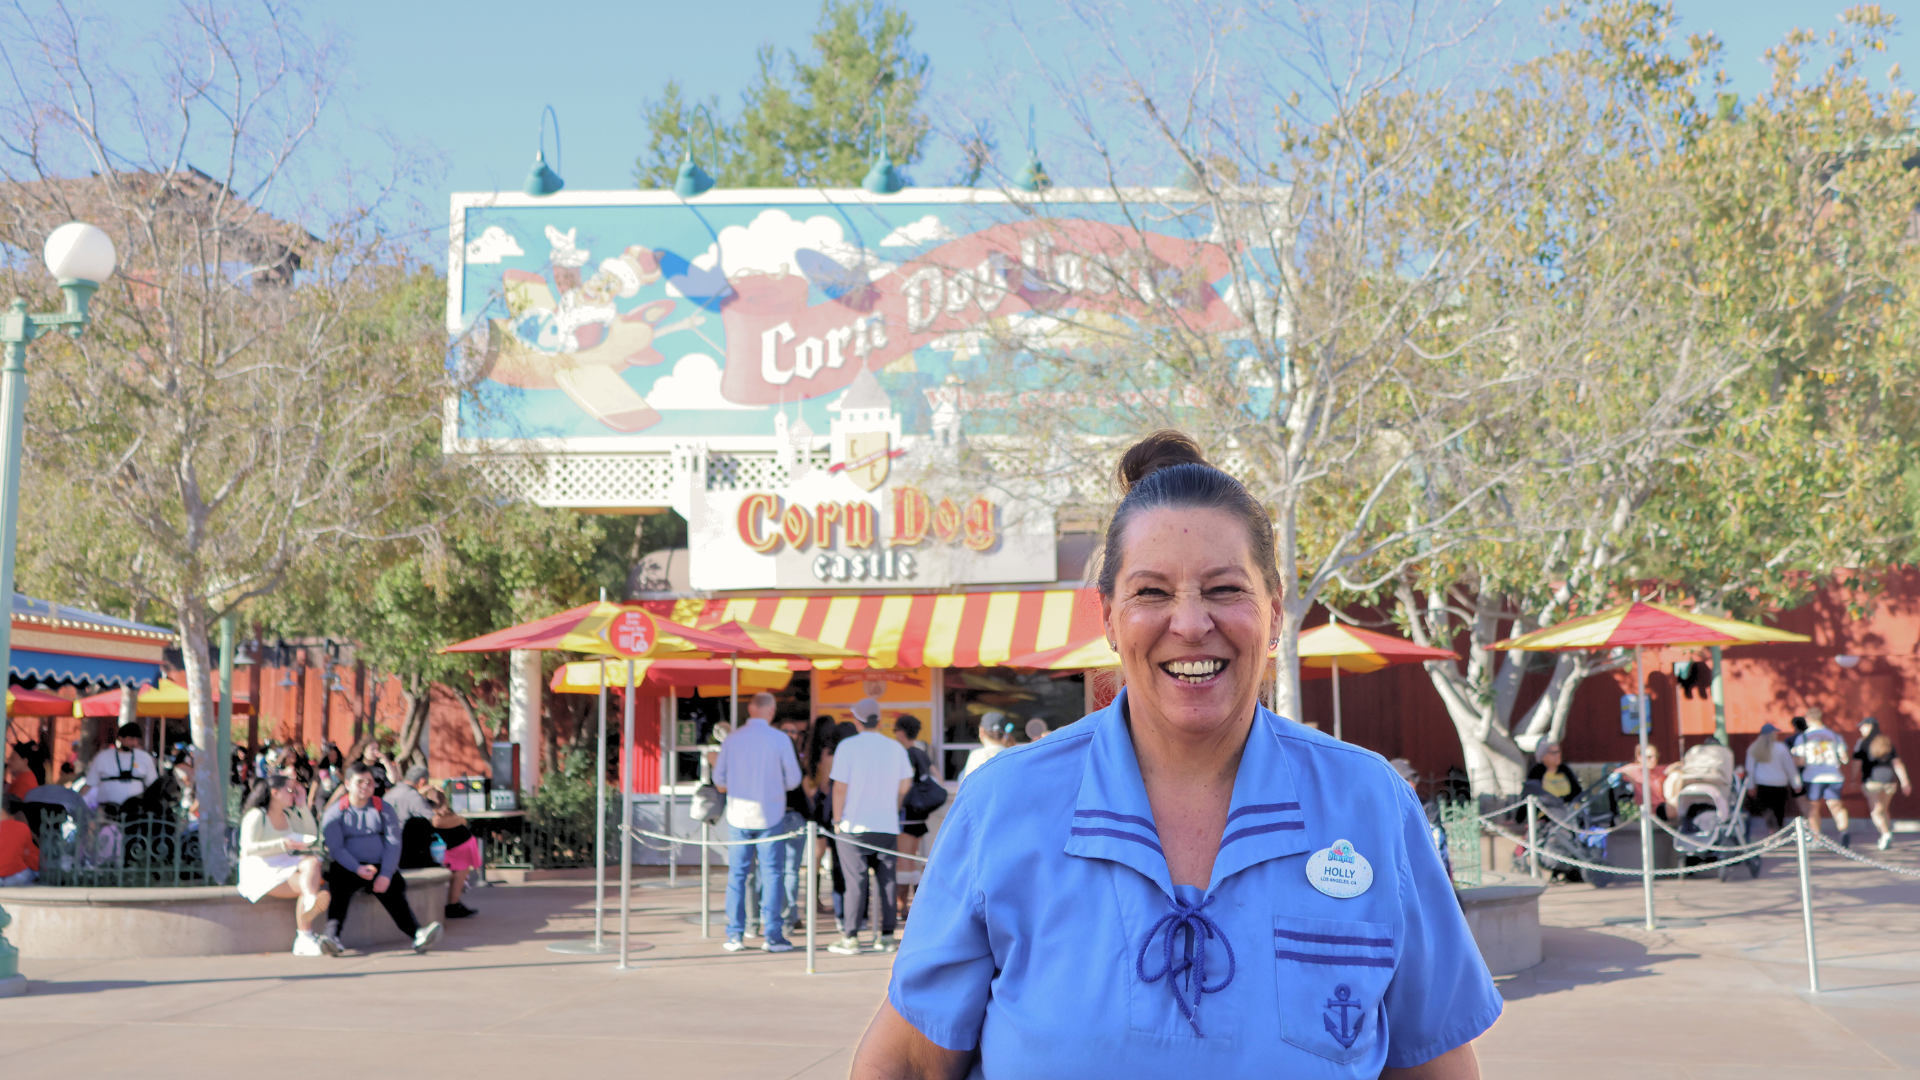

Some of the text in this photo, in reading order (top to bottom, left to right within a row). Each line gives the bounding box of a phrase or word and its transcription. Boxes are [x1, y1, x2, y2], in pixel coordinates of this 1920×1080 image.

[761, 311, 889, 385] Corn
[901, 260, 1009, 335] Dog
[737, 485, 996, 553] Corn Dog
[813, 551, 916, 581] castle
[1324, 866, 1355, 879] HOLLY
